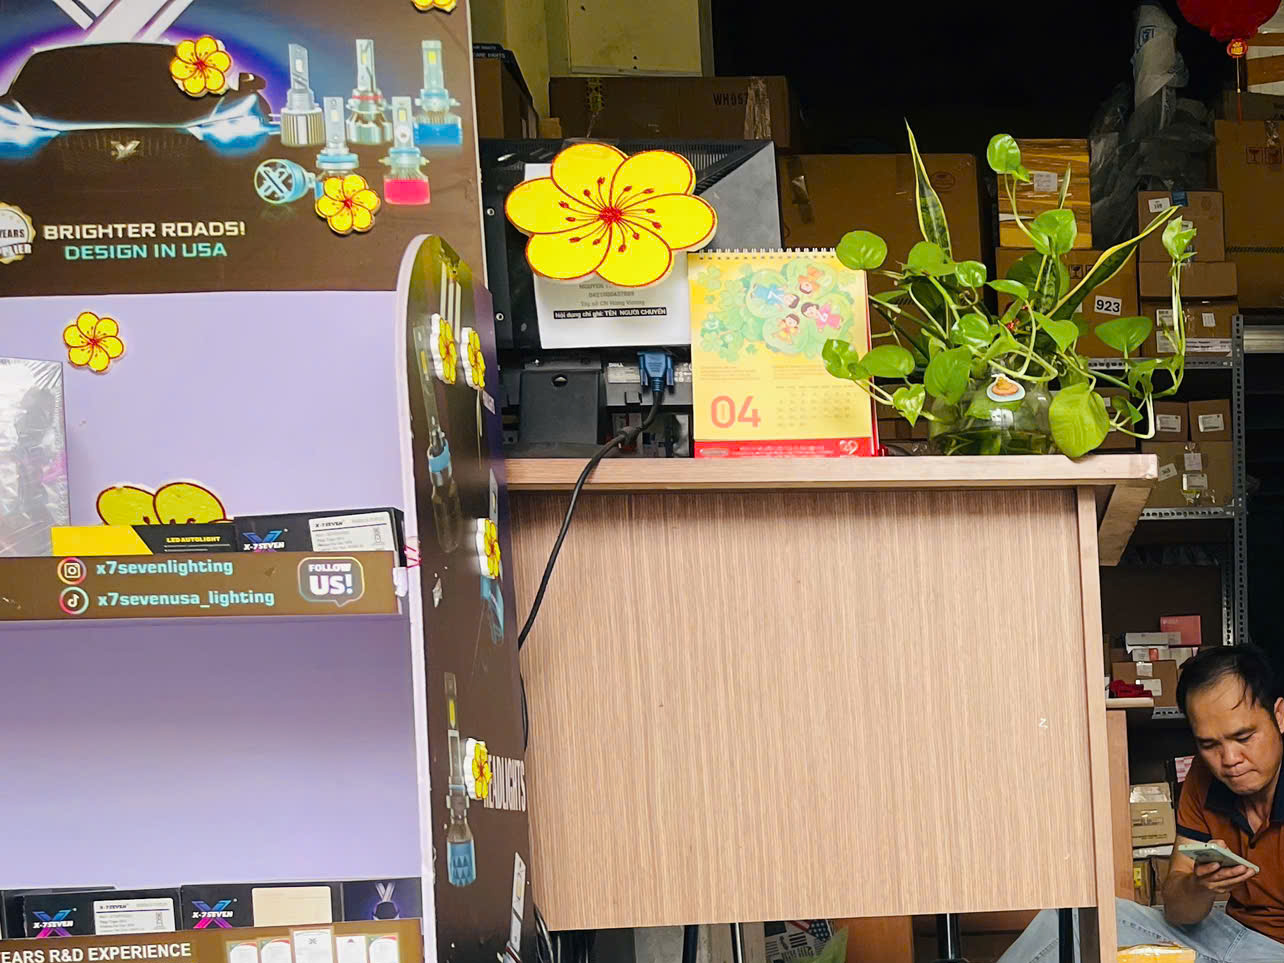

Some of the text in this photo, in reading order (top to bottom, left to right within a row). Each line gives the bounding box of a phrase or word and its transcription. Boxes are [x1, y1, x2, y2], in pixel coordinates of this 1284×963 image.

[43, 221, 246, 240] BRIGHTER ROADS!
[64, 242, 227, 260] DESIGN IN USA
[1096, 299, 1120, 312] 923
[711, 395, 761, 428] 04
[244, 541, 285, 550] X-7SEVEN
[96, 559, 234, 577] x7sevenlighting
[308, 563, 352, 572] FOLLOW
[310, 575, 353, 596] US!
[97, 590, 275, 608] x7sevenusa_lighting
[33, 920, 74, 928] X-7SEVEN
[192, 911, 233, 919] X-7SEVEN
[49, 948, 83, 962] R&D
[88, 943, 192, 961] EXPERIENCE
